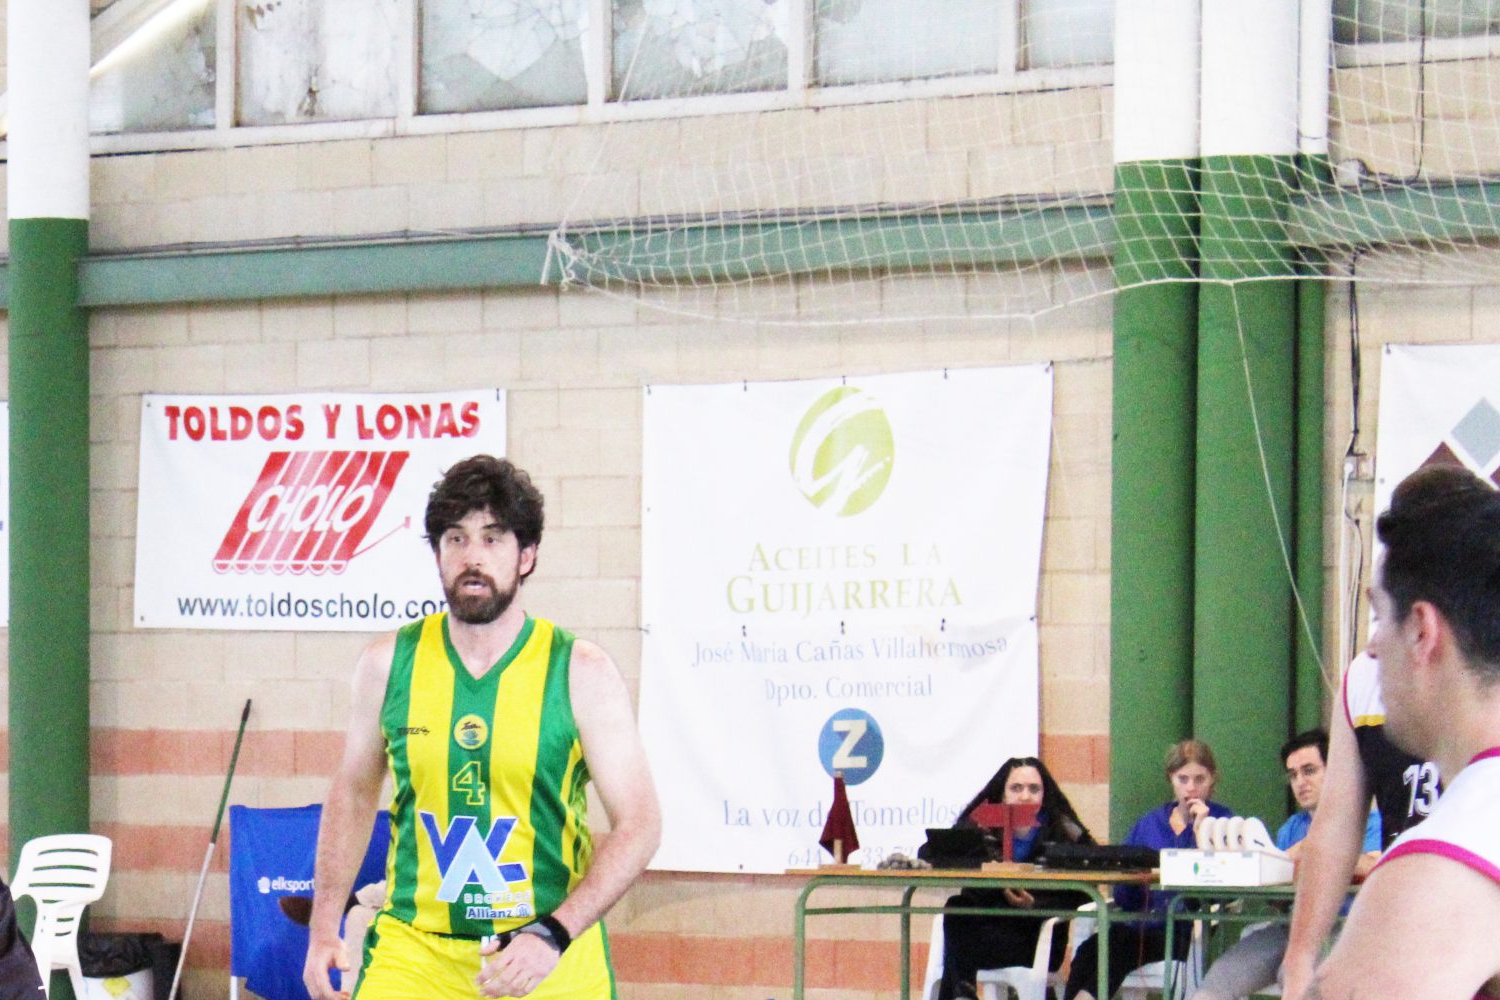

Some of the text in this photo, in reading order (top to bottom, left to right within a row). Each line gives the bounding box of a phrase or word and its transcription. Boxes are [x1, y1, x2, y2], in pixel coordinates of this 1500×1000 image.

[165, 401, 480, 441] TOLDOS Y LONAS
[247, 484, 374, 532] CHOLO
[748, 542, 877, 571] ACEITES
[726, 575, 964, 618] GUIJARRERA
[692, 641, 733, 668] José
[796, 640, 864, 663] Cañas
[872, 635, 1008, 660] Villahermosa
[764, 675, 932, 706] Dpto. Comercial
[832, 719, 868, 769] Z
[452, 760, 486, 805] 4
[723, 800, 751, 827] La
[762, 807, 800, 828] voz
[467, 906, 513, 918] Allianz
